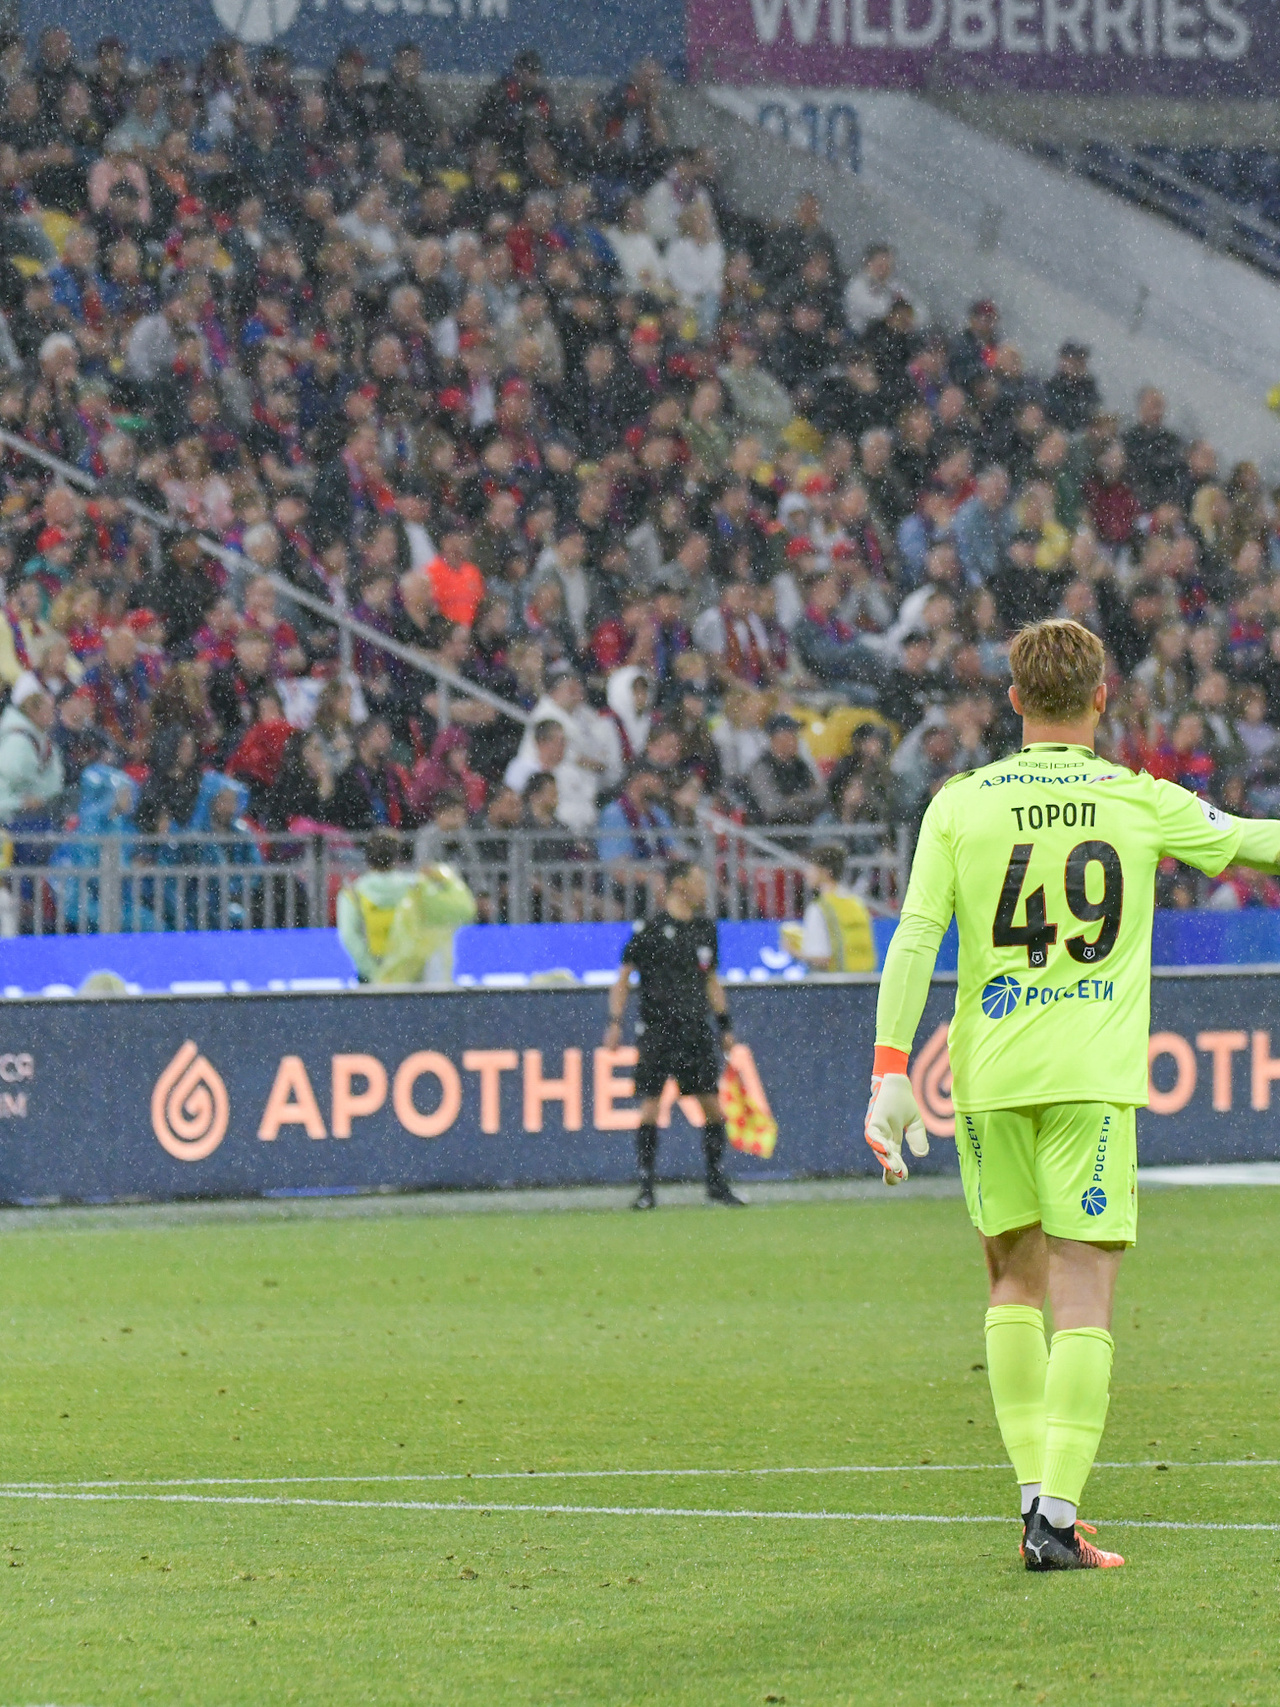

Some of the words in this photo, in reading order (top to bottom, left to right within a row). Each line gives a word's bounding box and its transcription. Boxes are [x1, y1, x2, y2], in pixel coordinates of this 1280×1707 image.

[748, 0, 1251, 61] WILDBERRIES
[979, 773, 1091, 789] АЭРОФЛОТ
[1011, 802, 1096, 831] ТОРОП
[992, 840, 1125, 968] 49
[1092, 1115, 1111, 1182] РОССЕТИ
